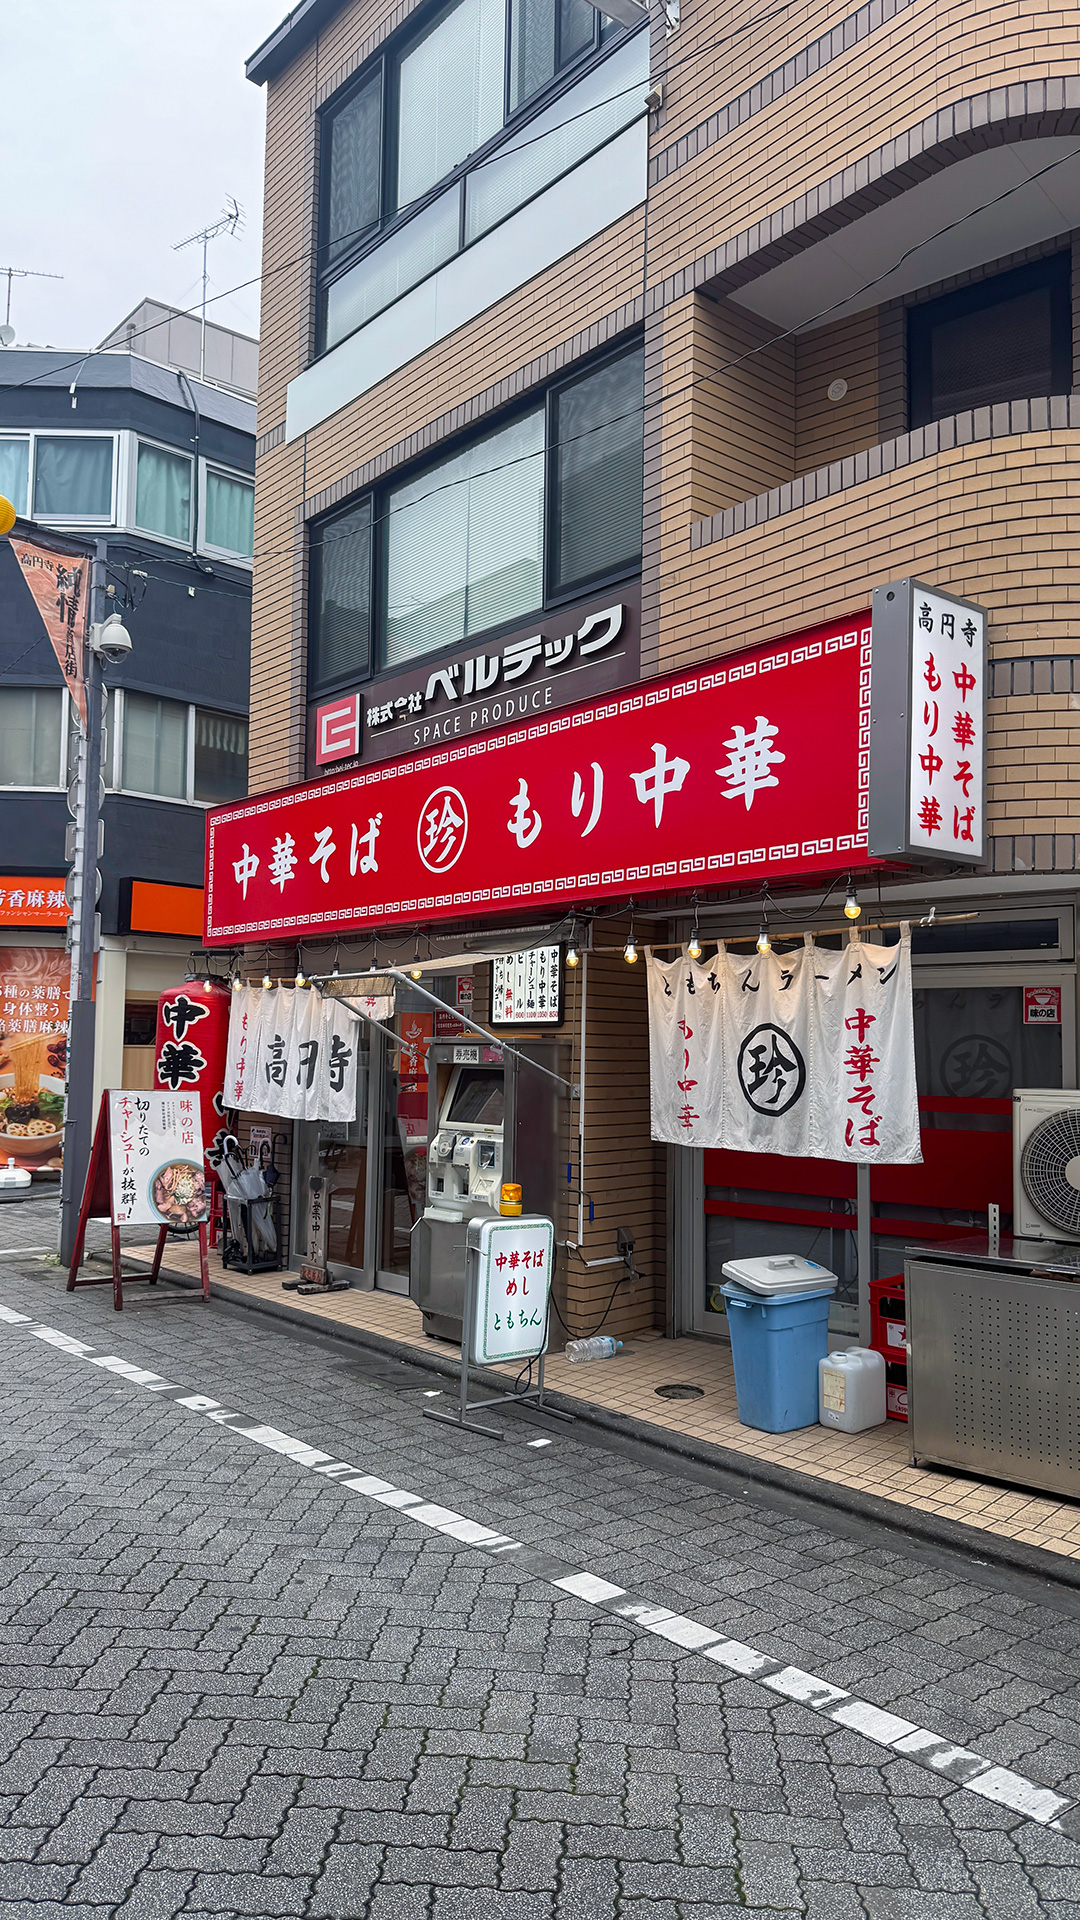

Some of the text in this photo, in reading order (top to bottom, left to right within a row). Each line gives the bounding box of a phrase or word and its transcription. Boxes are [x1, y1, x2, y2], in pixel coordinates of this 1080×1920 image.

[21, 553, 54, 571] 高円寺
[918, 601, 977, 648] 高円寺
[413, 687, 552, 745] SPACE PRODUCE
[918, 652, 943, 837] もり中華
[952, 662, 976, 842] 中華そば
[232, 715, 786, 900] 中華そば 珍 もり中華
[516, 953, 524, 1009] ビール
[527, 951, 535, 1009] チャーシュー麺
[538, 951, 547, 1009] もり中華
[550, 949, 559, 1008] 中華そば
[661, 963, 897, 996] ともちんラーメン
[3, 1002, 59, 1017] 身体整う
[1030, 1008, 1056, 1018] 味の店
[158, 995, 208, 1090] 中華
[234, 1012, 248, 1102] もり中華
[265, 1033, 353, 1093] 高円寺
[455, 1049, 478, 1061] 券売機
[748, 1034, 798, 1104] 珍
[843, 1008, 881, 1147] 中華そば
[134, 1096, 150, 1157] 切りたての
[180, 1099, 195, 1145] 味の店
[494, 1248, 545, 1273] 中華そば
[505, 1276, 530, 1297] めし
[492, 1307, 543, 1331] ともちん
